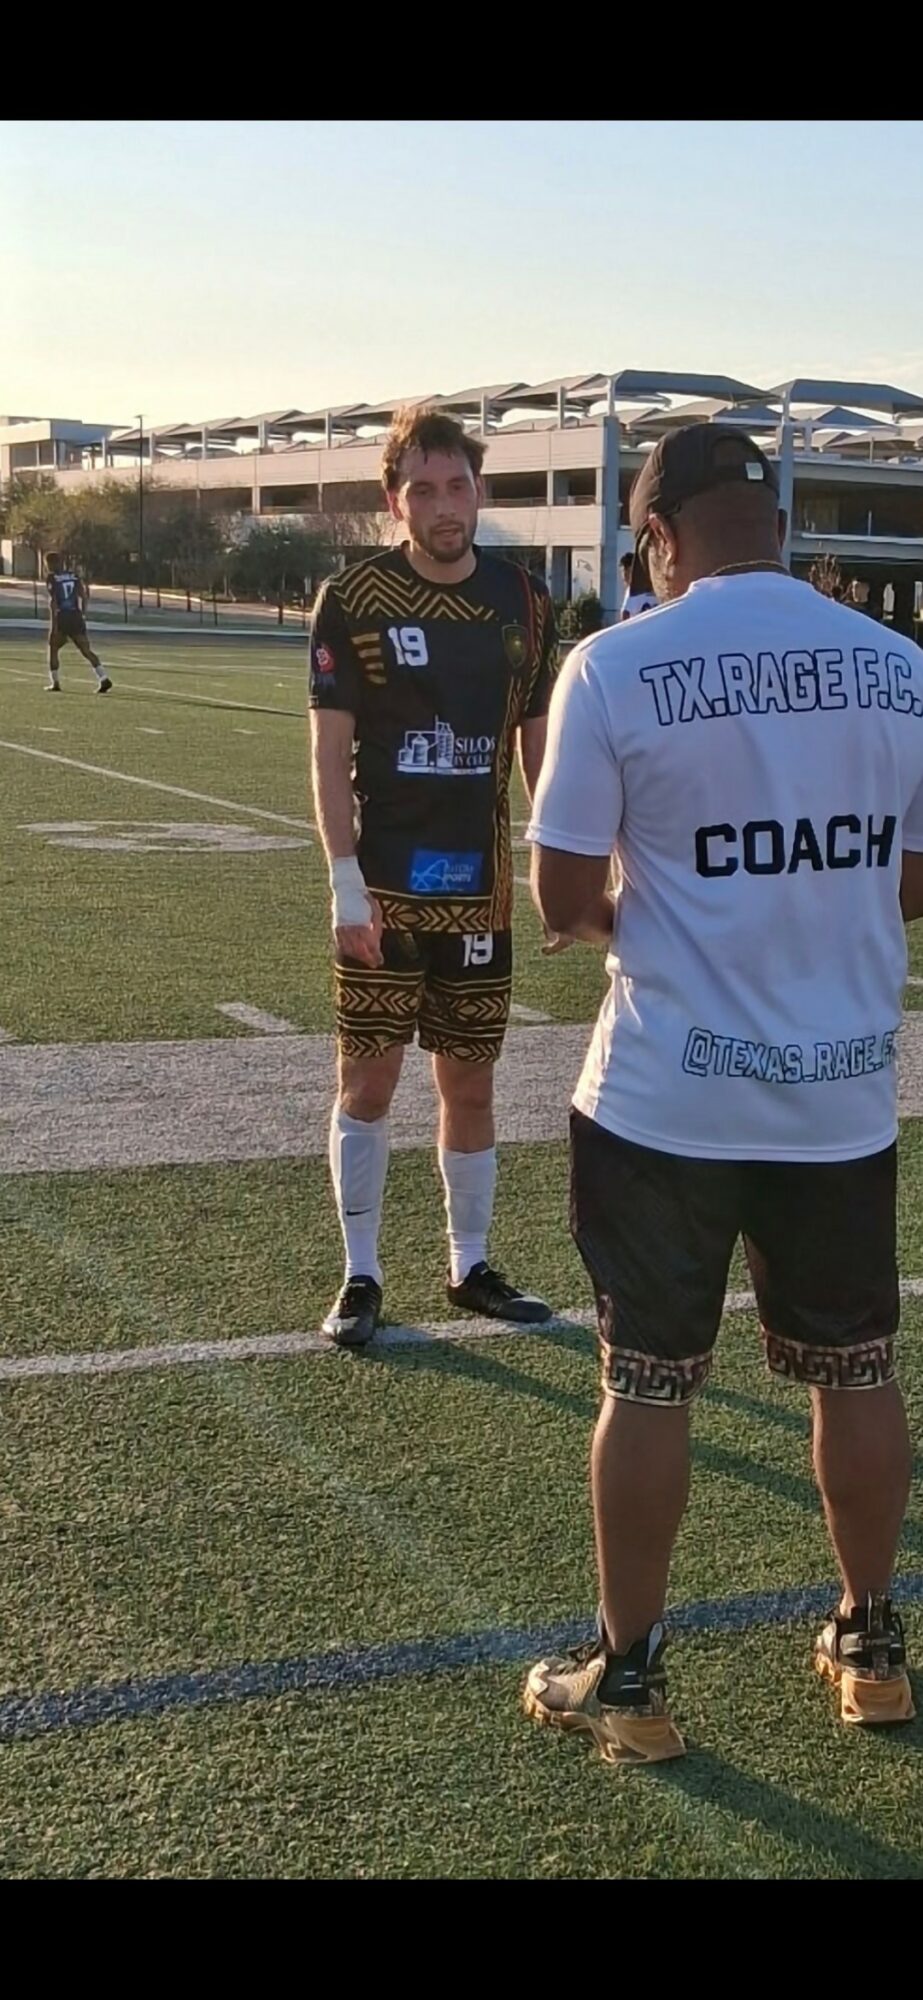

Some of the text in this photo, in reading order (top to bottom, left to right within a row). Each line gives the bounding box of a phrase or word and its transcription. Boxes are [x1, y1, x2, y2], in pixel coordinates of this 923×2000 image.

[387, 627, 429, 666] 19
[639, 649, 848, 726] TX.RAGE
[694, 814, 897, 878] COACH
[462, 932, 493, 967] 19
